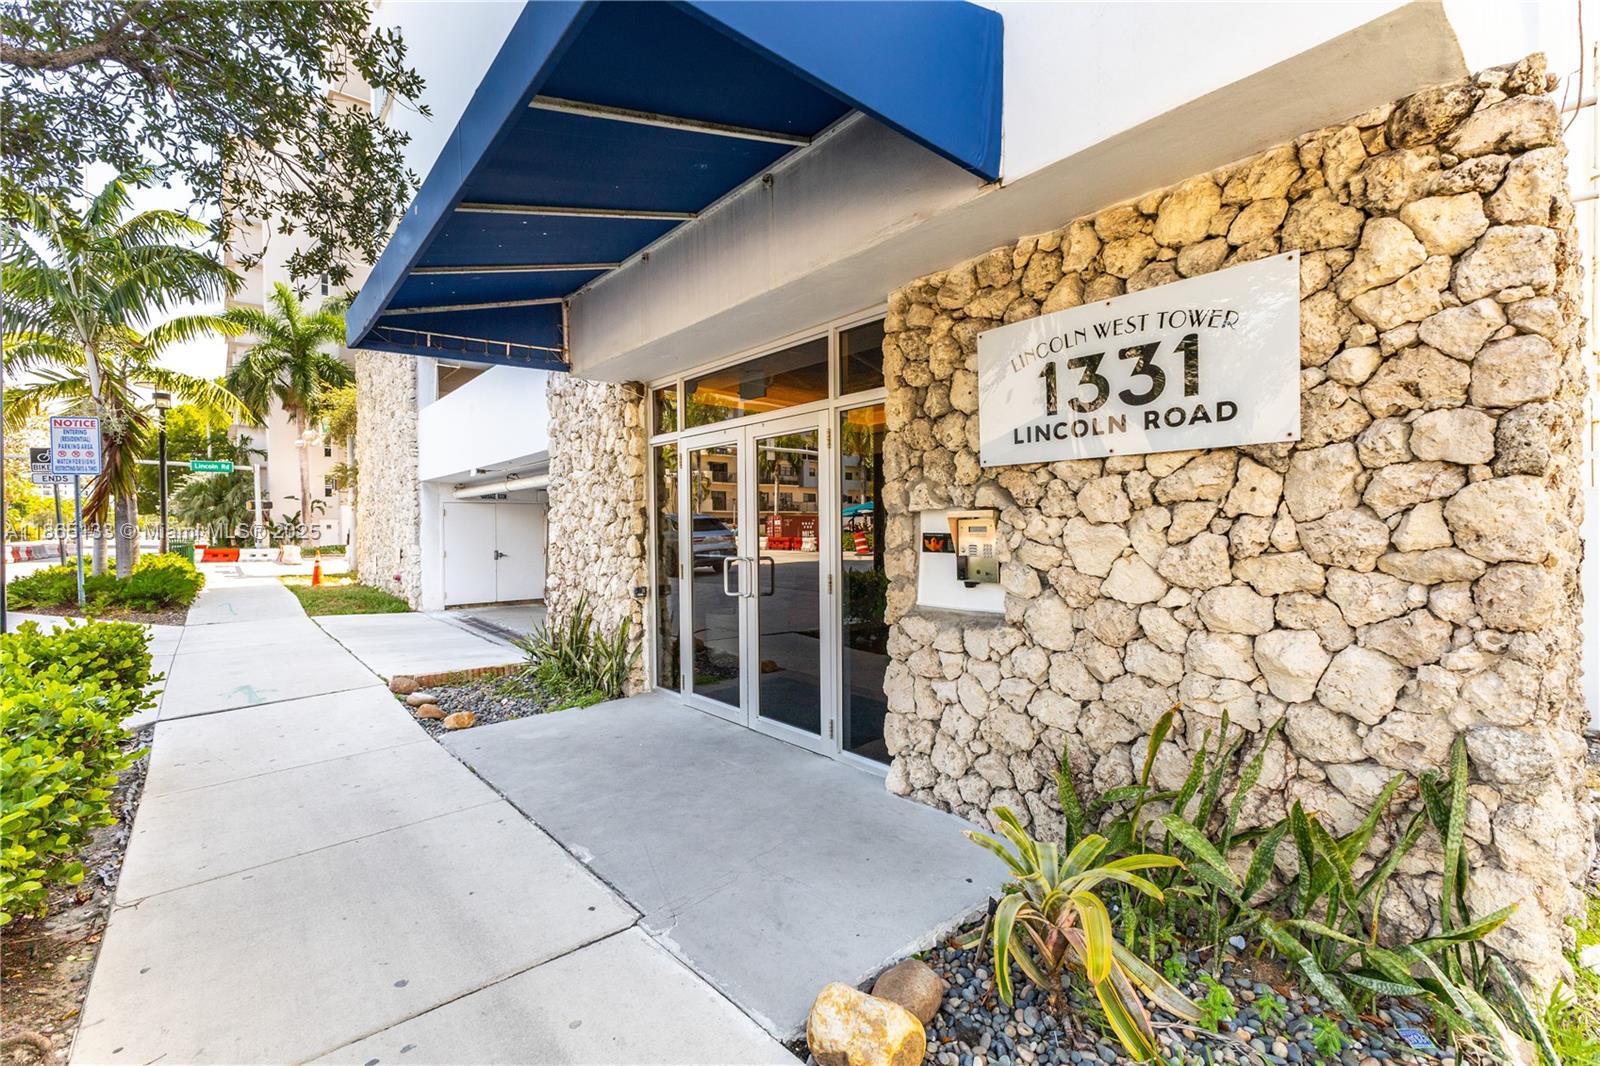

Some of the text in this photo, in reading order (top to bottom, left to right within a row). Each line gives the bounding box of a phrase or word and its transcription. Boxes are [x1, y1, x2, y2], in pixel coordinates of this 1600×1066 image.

[1011, 308, 1240, 373] LINCOLN WEST TOWER
[1038, 333, 1199, 417] 1331
[53, 419, 96, 427] NOTICE
[1013, 400, 1238, 445] LINCOLN ROAD
